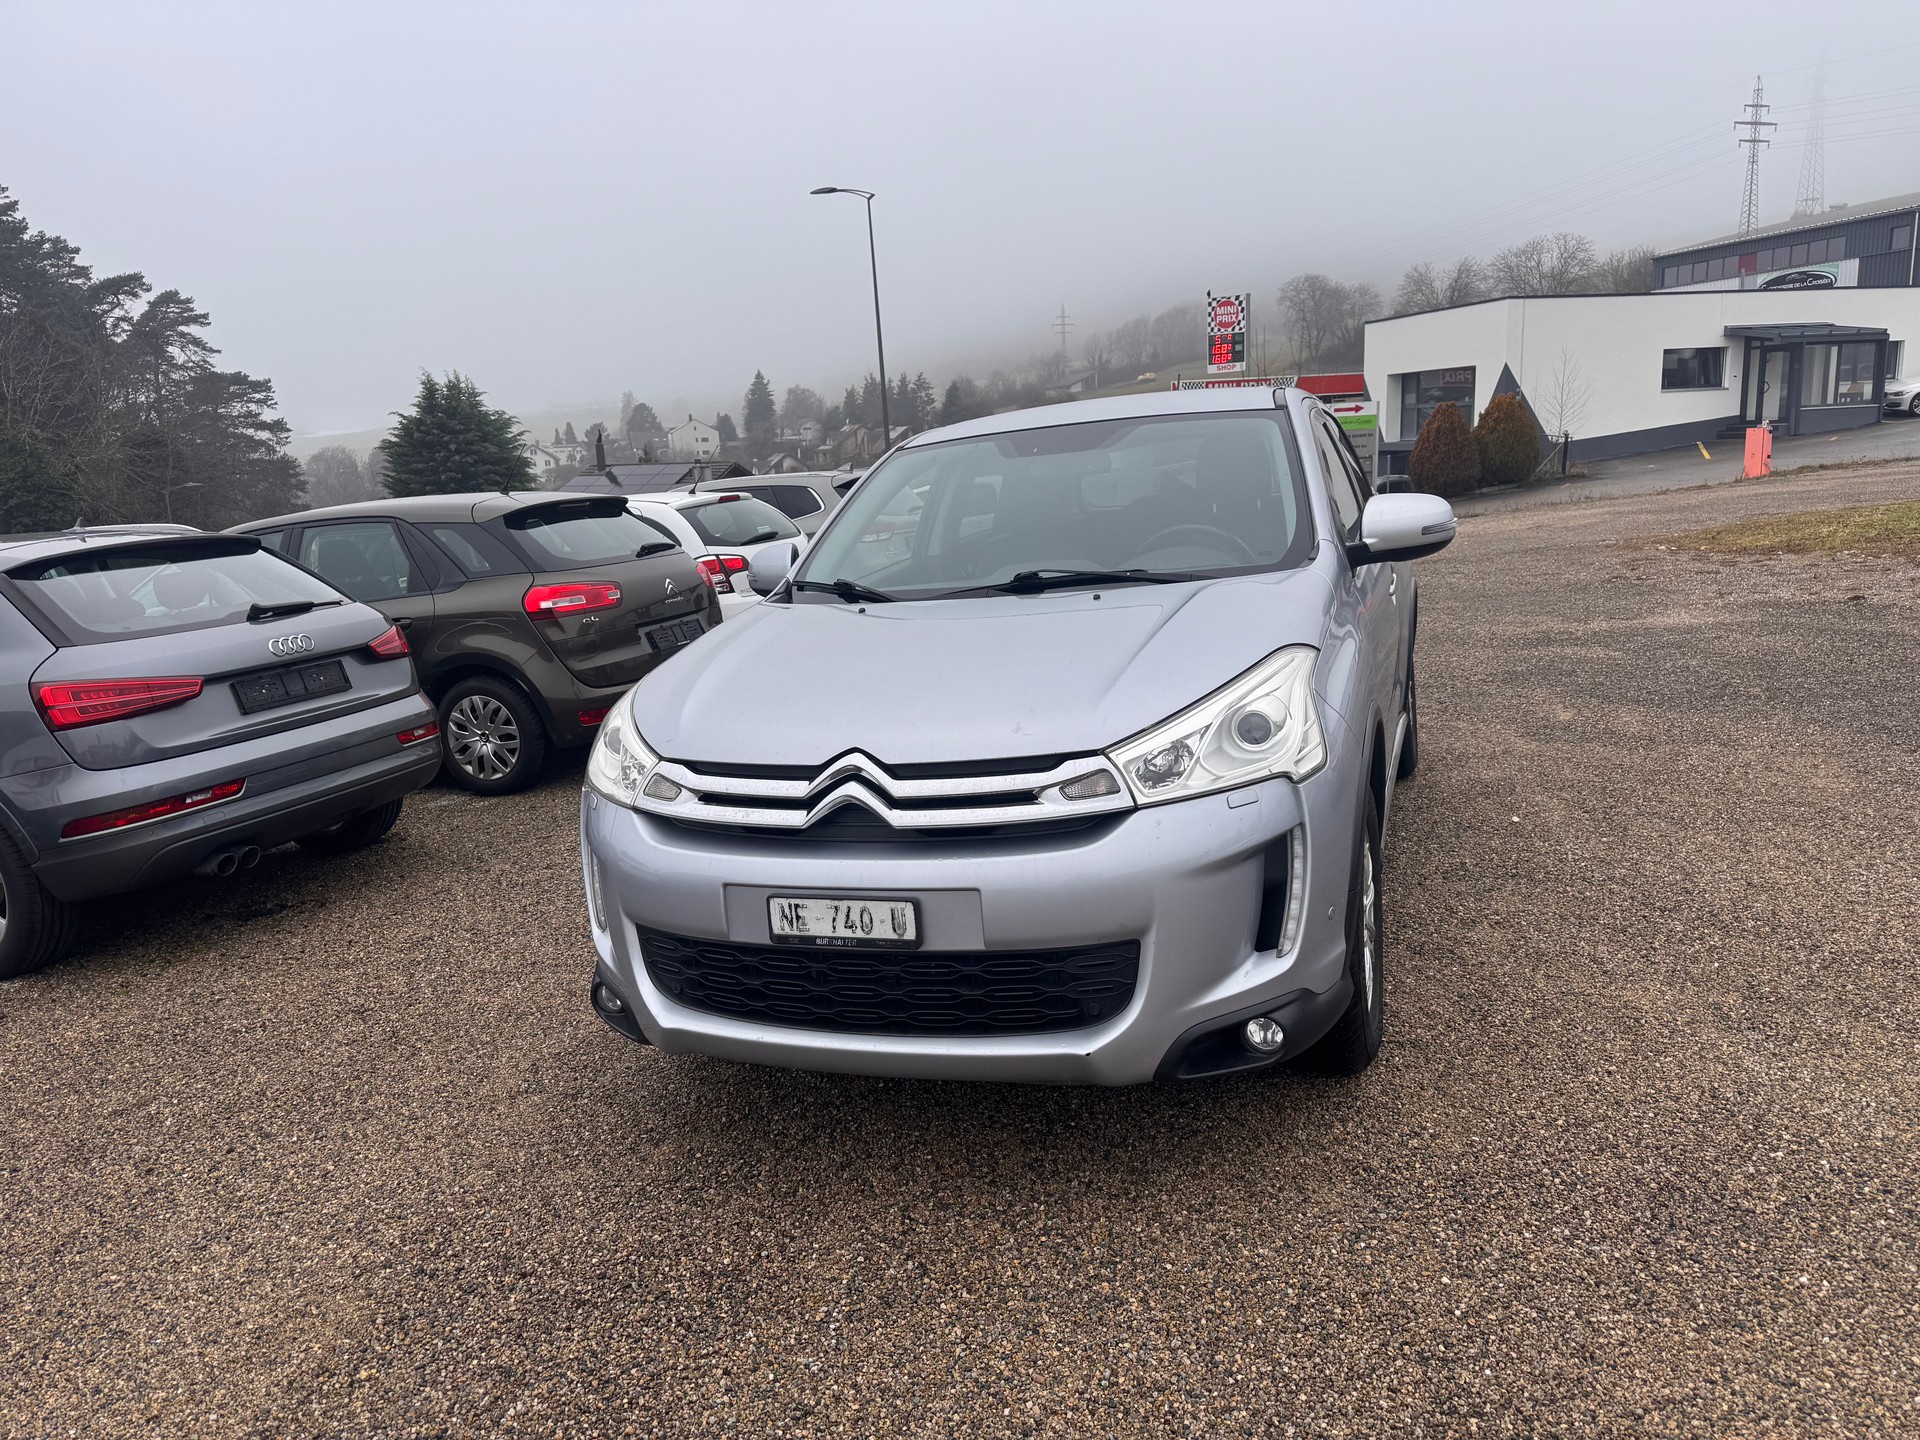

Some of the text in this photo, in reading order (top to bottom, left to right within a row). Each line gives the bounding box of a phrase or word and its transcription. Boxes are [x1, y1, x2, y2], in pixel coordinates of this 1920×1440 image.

[1216, 305, 1237, 315] MINI
[1216, 314, 1237, 324] PRIX
[1216, 364, 1236, 372] SHOP
[777, 902, 907, 936] NE 740 U
